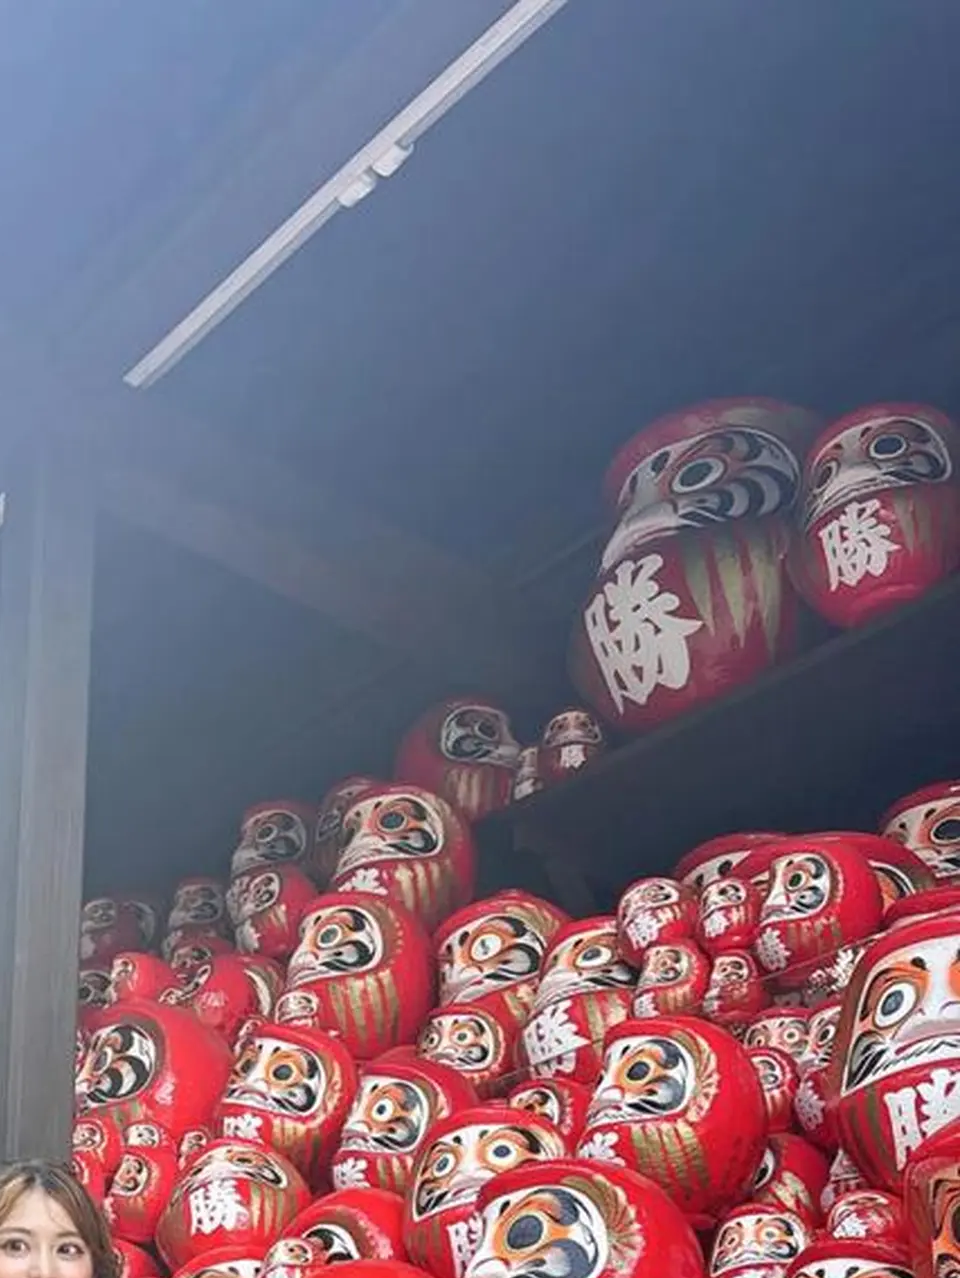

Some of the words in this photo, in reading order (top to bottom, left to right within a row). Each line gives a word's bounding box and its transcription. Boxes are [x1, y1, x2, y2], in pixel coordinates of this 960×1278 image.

[819, 499, 901, 592] 勝
[585, 554, 703, 715] 勝
[190, 1178, 248, 1234] 勝
